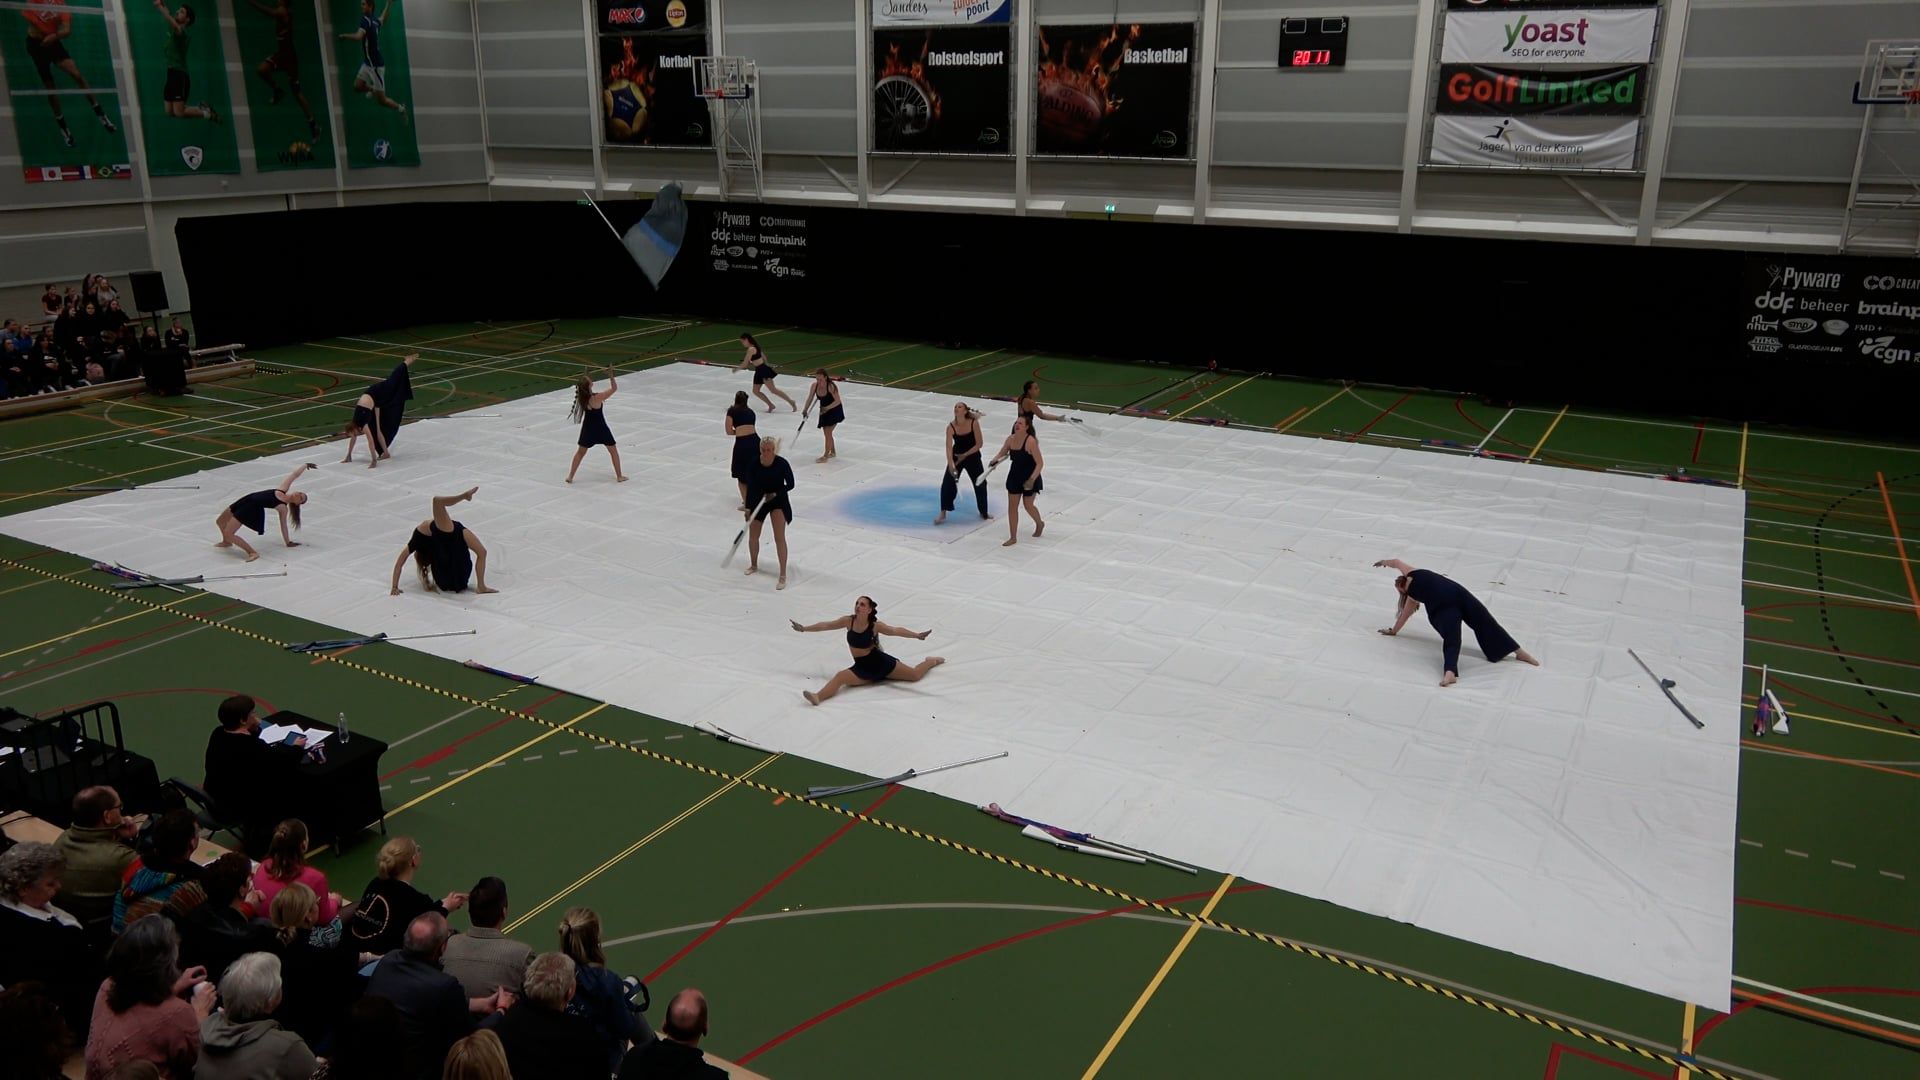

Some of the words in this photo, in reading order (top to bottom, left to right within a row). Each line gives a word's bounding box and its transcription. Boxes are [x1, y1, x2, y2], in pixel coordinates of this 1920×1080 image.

[608, 8, 635, 24] MAX
[966, 0, 990, 21] poort
[928, 50, 1004, 67] Rolstoelsport
[1124, 47, 1188, 65] Basketbal
[1511, 48, 1529, 57] SEO
[1531, 48, 1546, 57] for
[1546, 48, 1586, 58] everyone
[659, 55, 692, 69] Korfbal
[1515, 144, 1532, 152] van
[1535, 143, 1552, 153] der
[1554, 143, 1584, 156] Kamp
[722, 211, 750, 227] Pyware
[711, 228, 731, 244] ddf
[733, 232, 756, 242] beheer
[759, 233, 806, 247] brainpink
[771, 266, 789, 277] cgn
[1783, 266, 1842, 290] Pyware
[1755, 291, 1795, 314] ddf
[1800, 297, 1850, 313] beheer
[1873, 348, 1912, 365] cgn
